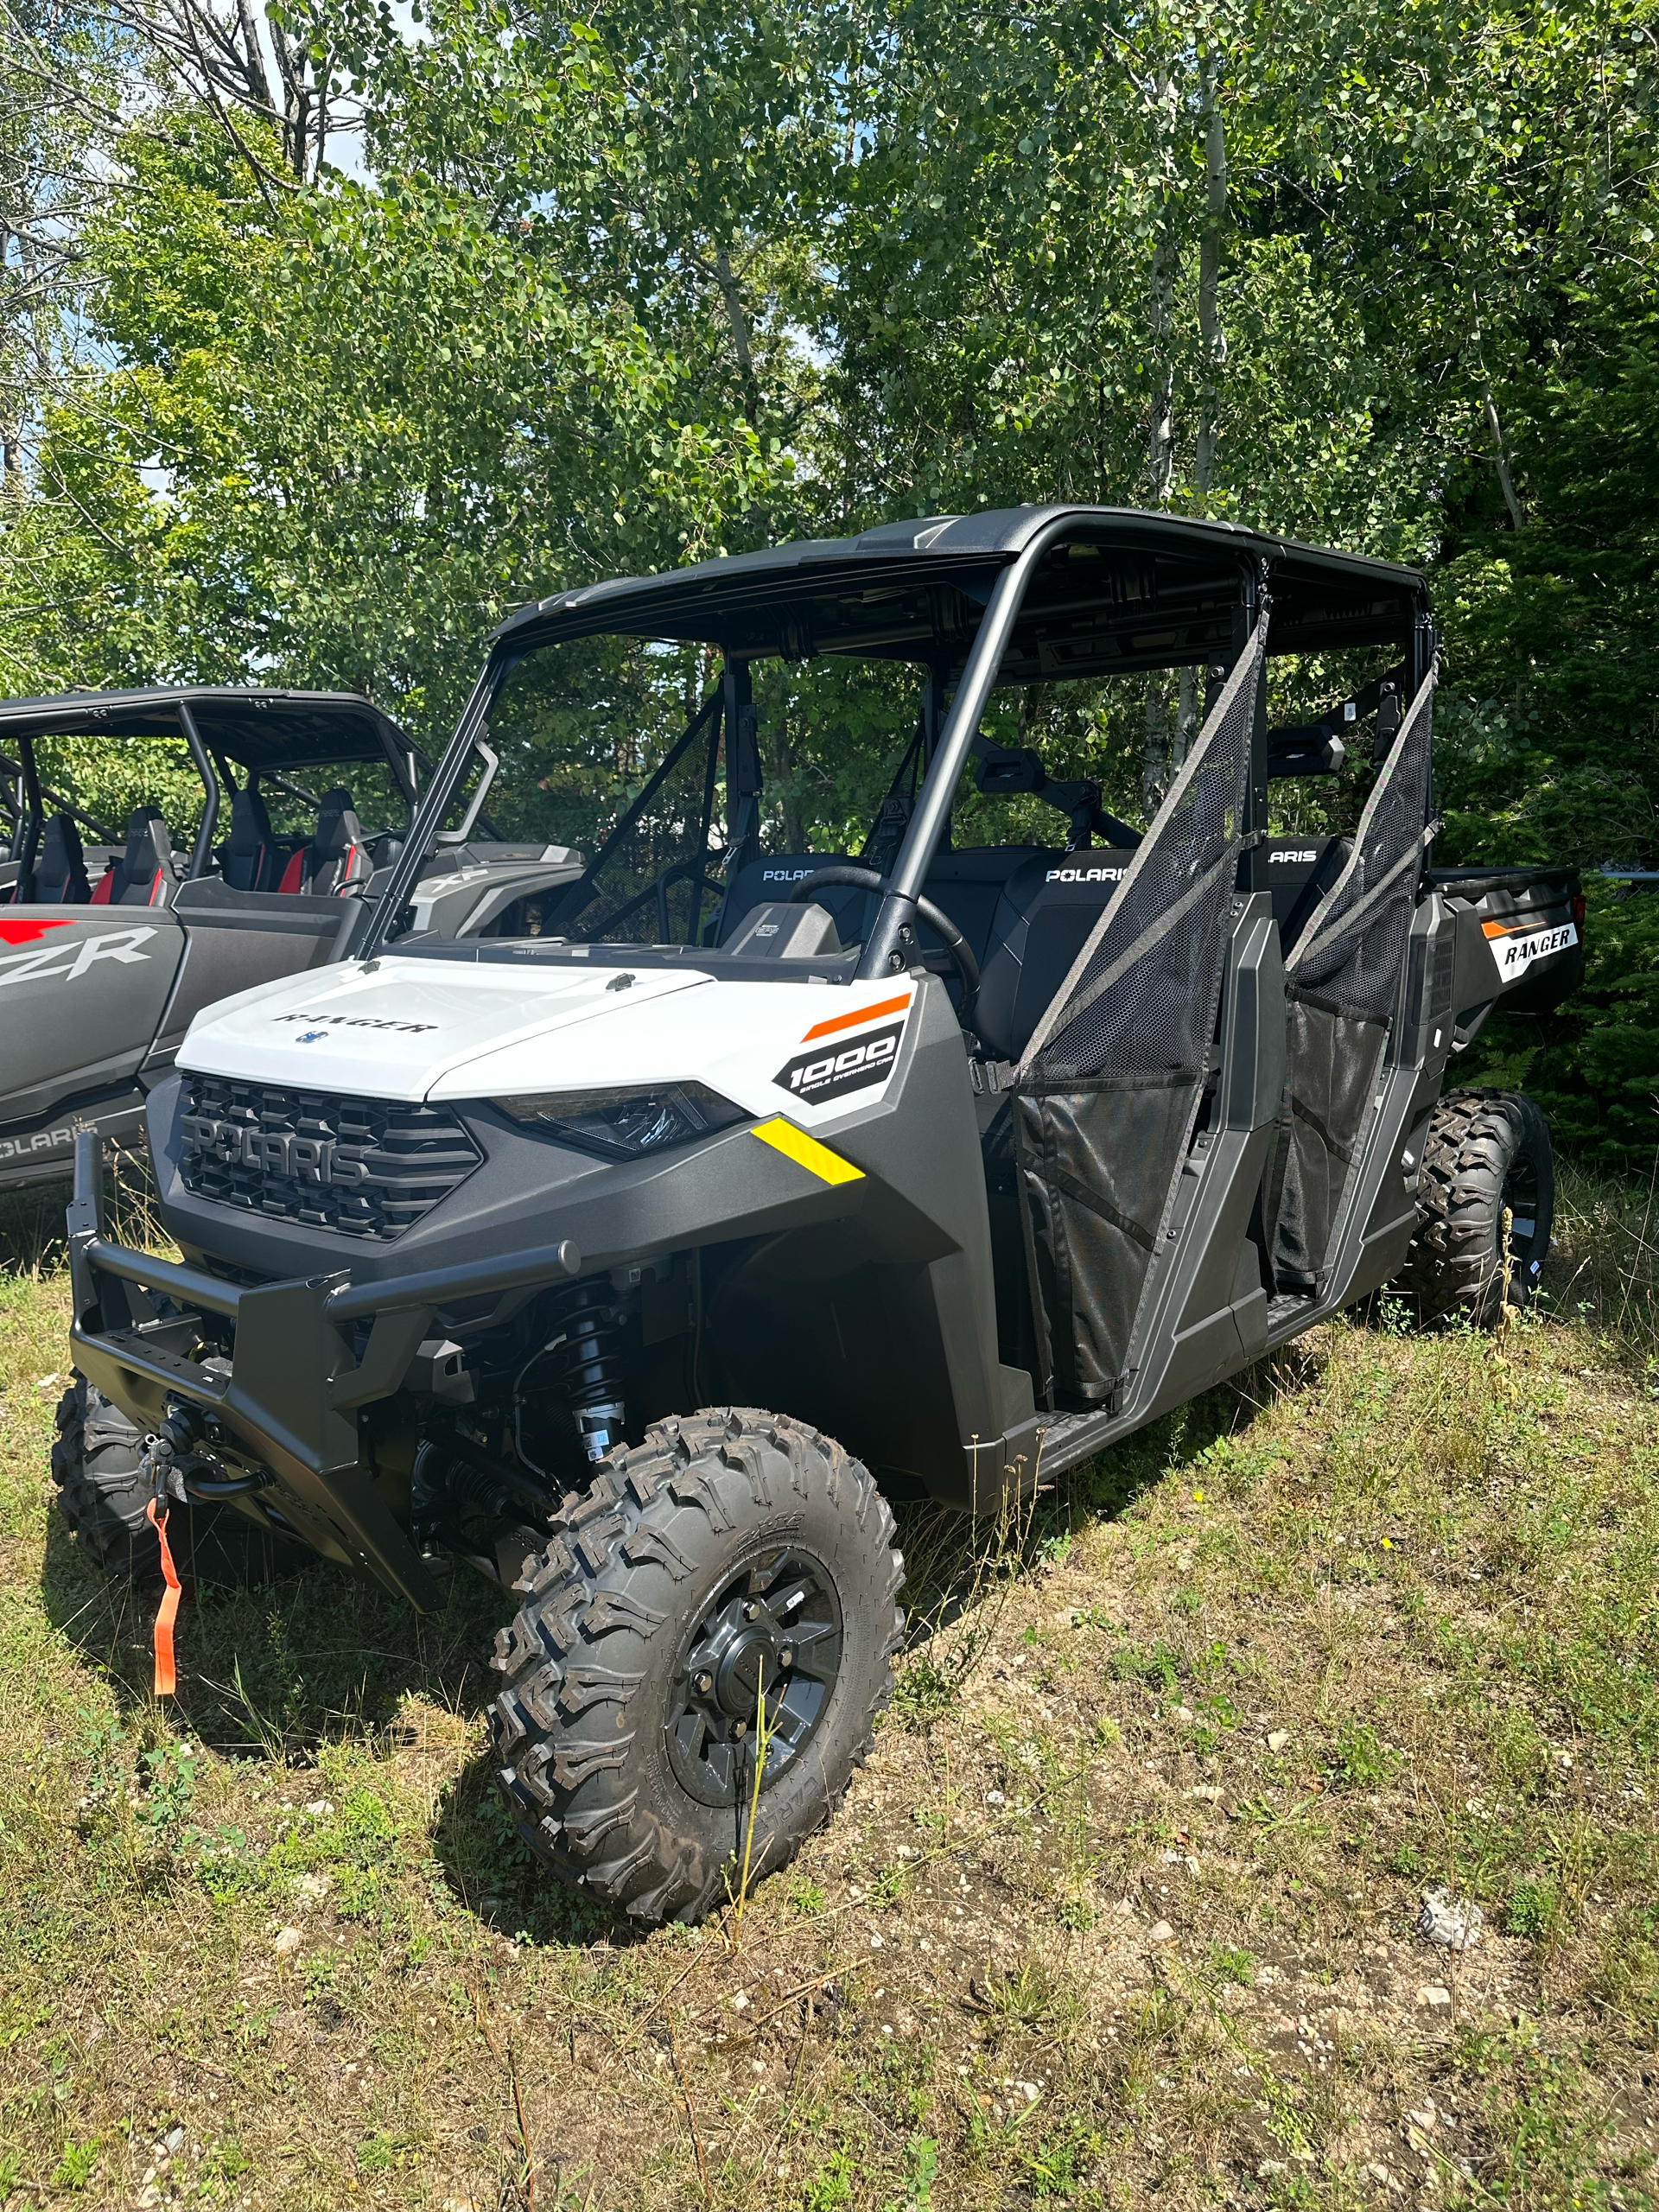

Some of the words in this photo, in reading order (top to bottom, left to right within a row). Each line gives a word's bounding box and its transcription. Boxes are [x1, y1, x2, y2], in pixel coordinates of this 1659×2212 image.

[1267, 850, 1317, 863] ARIS
[429, 868, 489, 894] XP
[1045, 868, 1128, 882] POLARI
[1504, 929, 1570, 965] RANGER
[270, 1014, 439, 1033] RANGER
[790, 1035, 896, 1089] 1000
[799, 1078, 831, 1094] SINGLE
[833, 1062, 875, 1081] OVERHEAD
[876, 1055, 894, 1066] CAM
[194, 1115, 372, 1187] POLARIS
